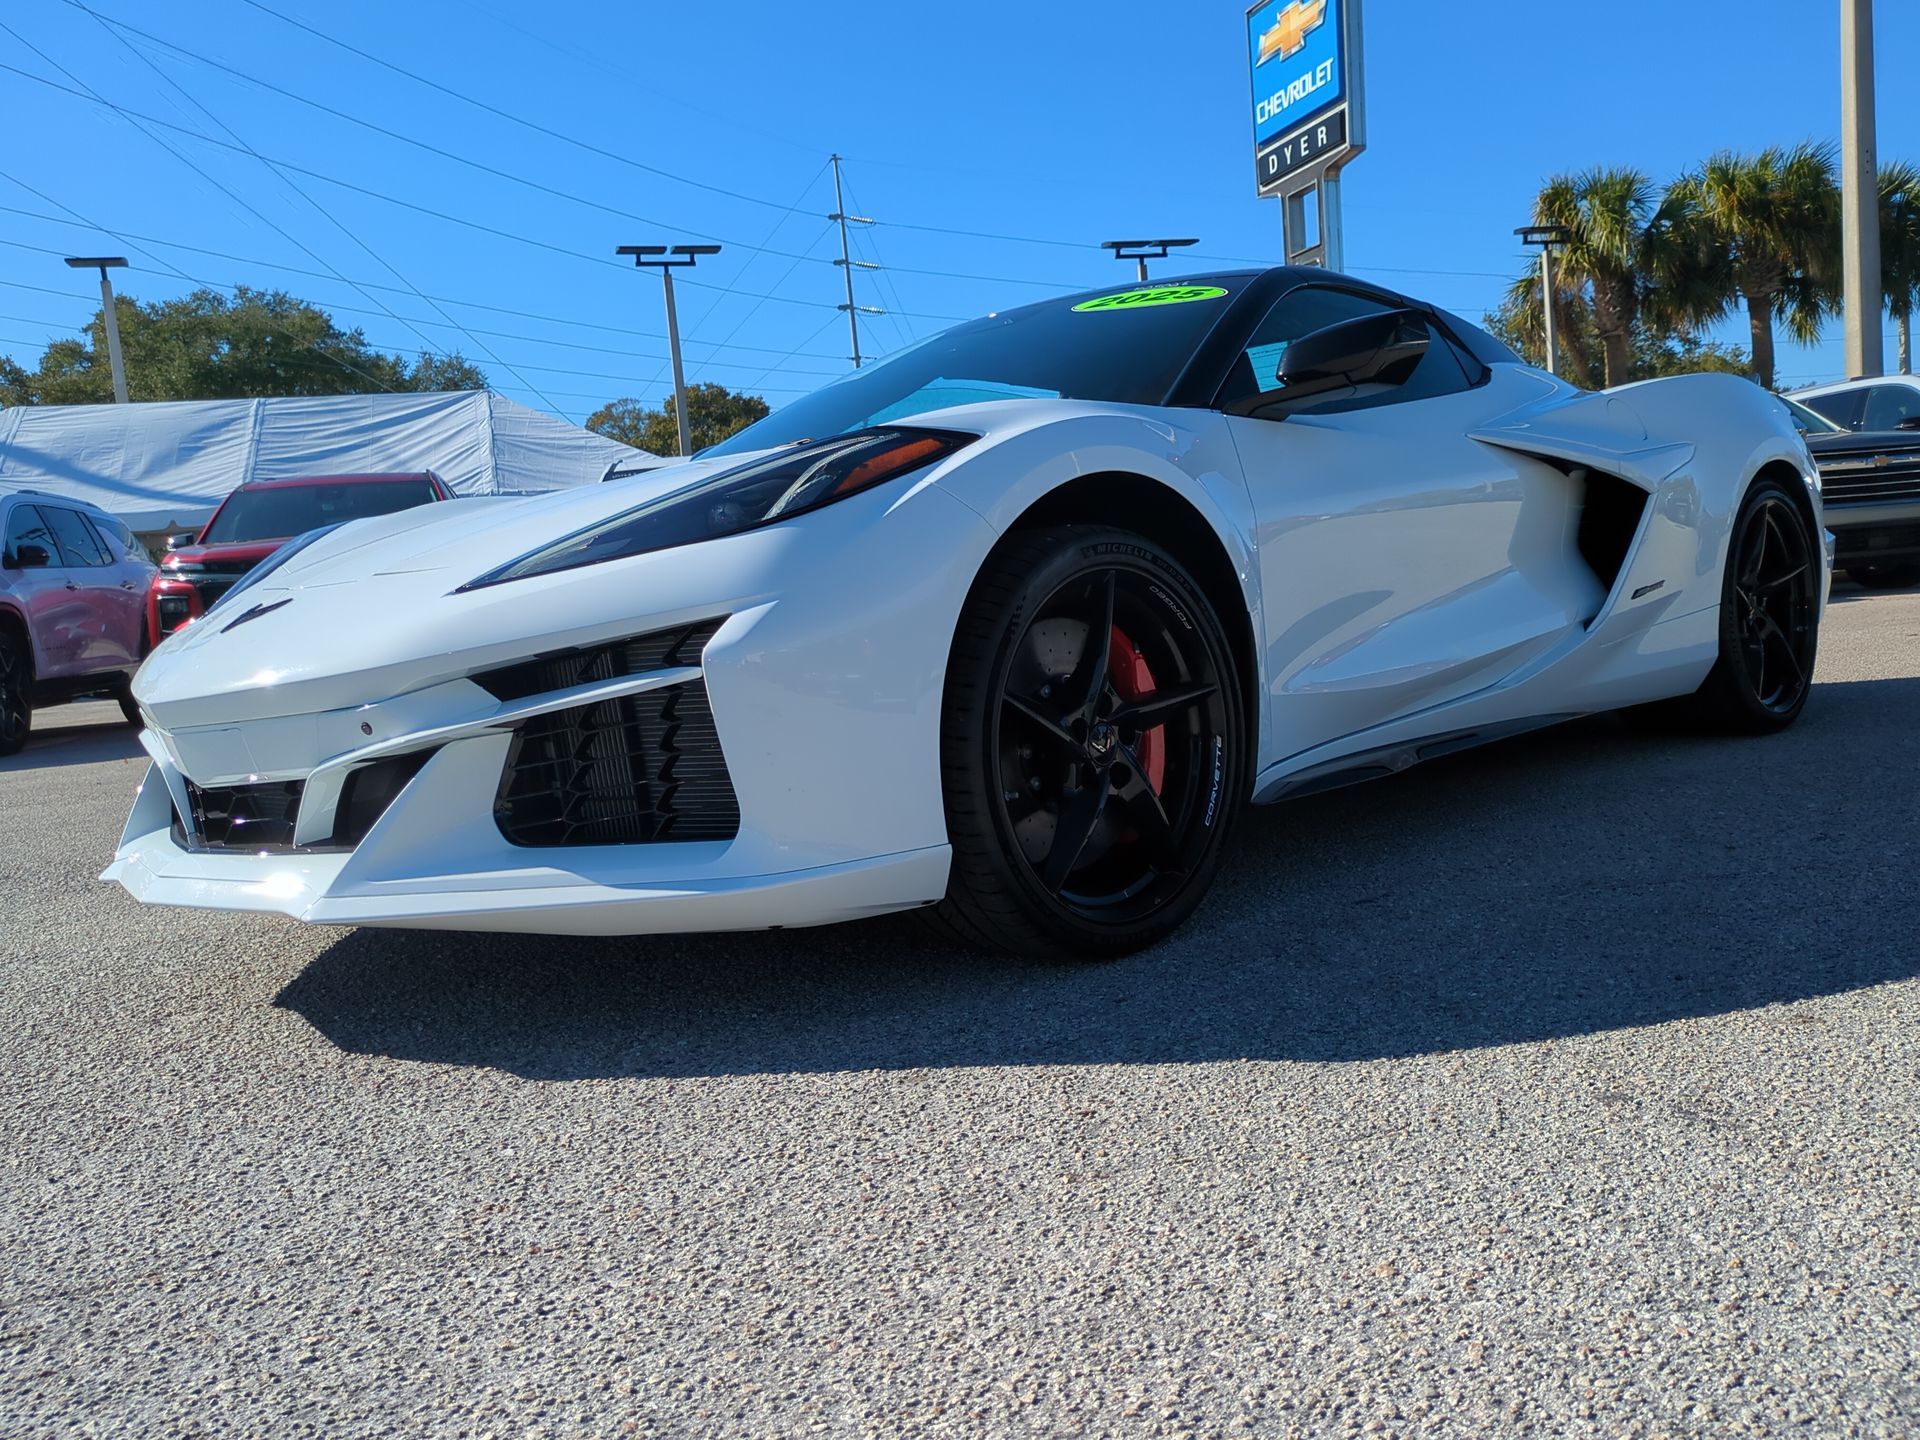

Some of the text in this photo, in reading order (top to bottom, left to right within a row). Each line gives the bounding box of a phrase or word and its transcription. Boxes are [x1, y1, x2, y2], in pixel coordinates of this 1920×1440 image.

[1256, 57, 1334, 124] CHEVROLET
[1268, 126, 1327, 174] DYER
[1083, 288, 1214, 310] 2025
[1097, 543, 1153, 561] MICHELIN
[1149, 585, 1192, 630] FORGED
[1205, 735, 1222, 826] CORVETTE
